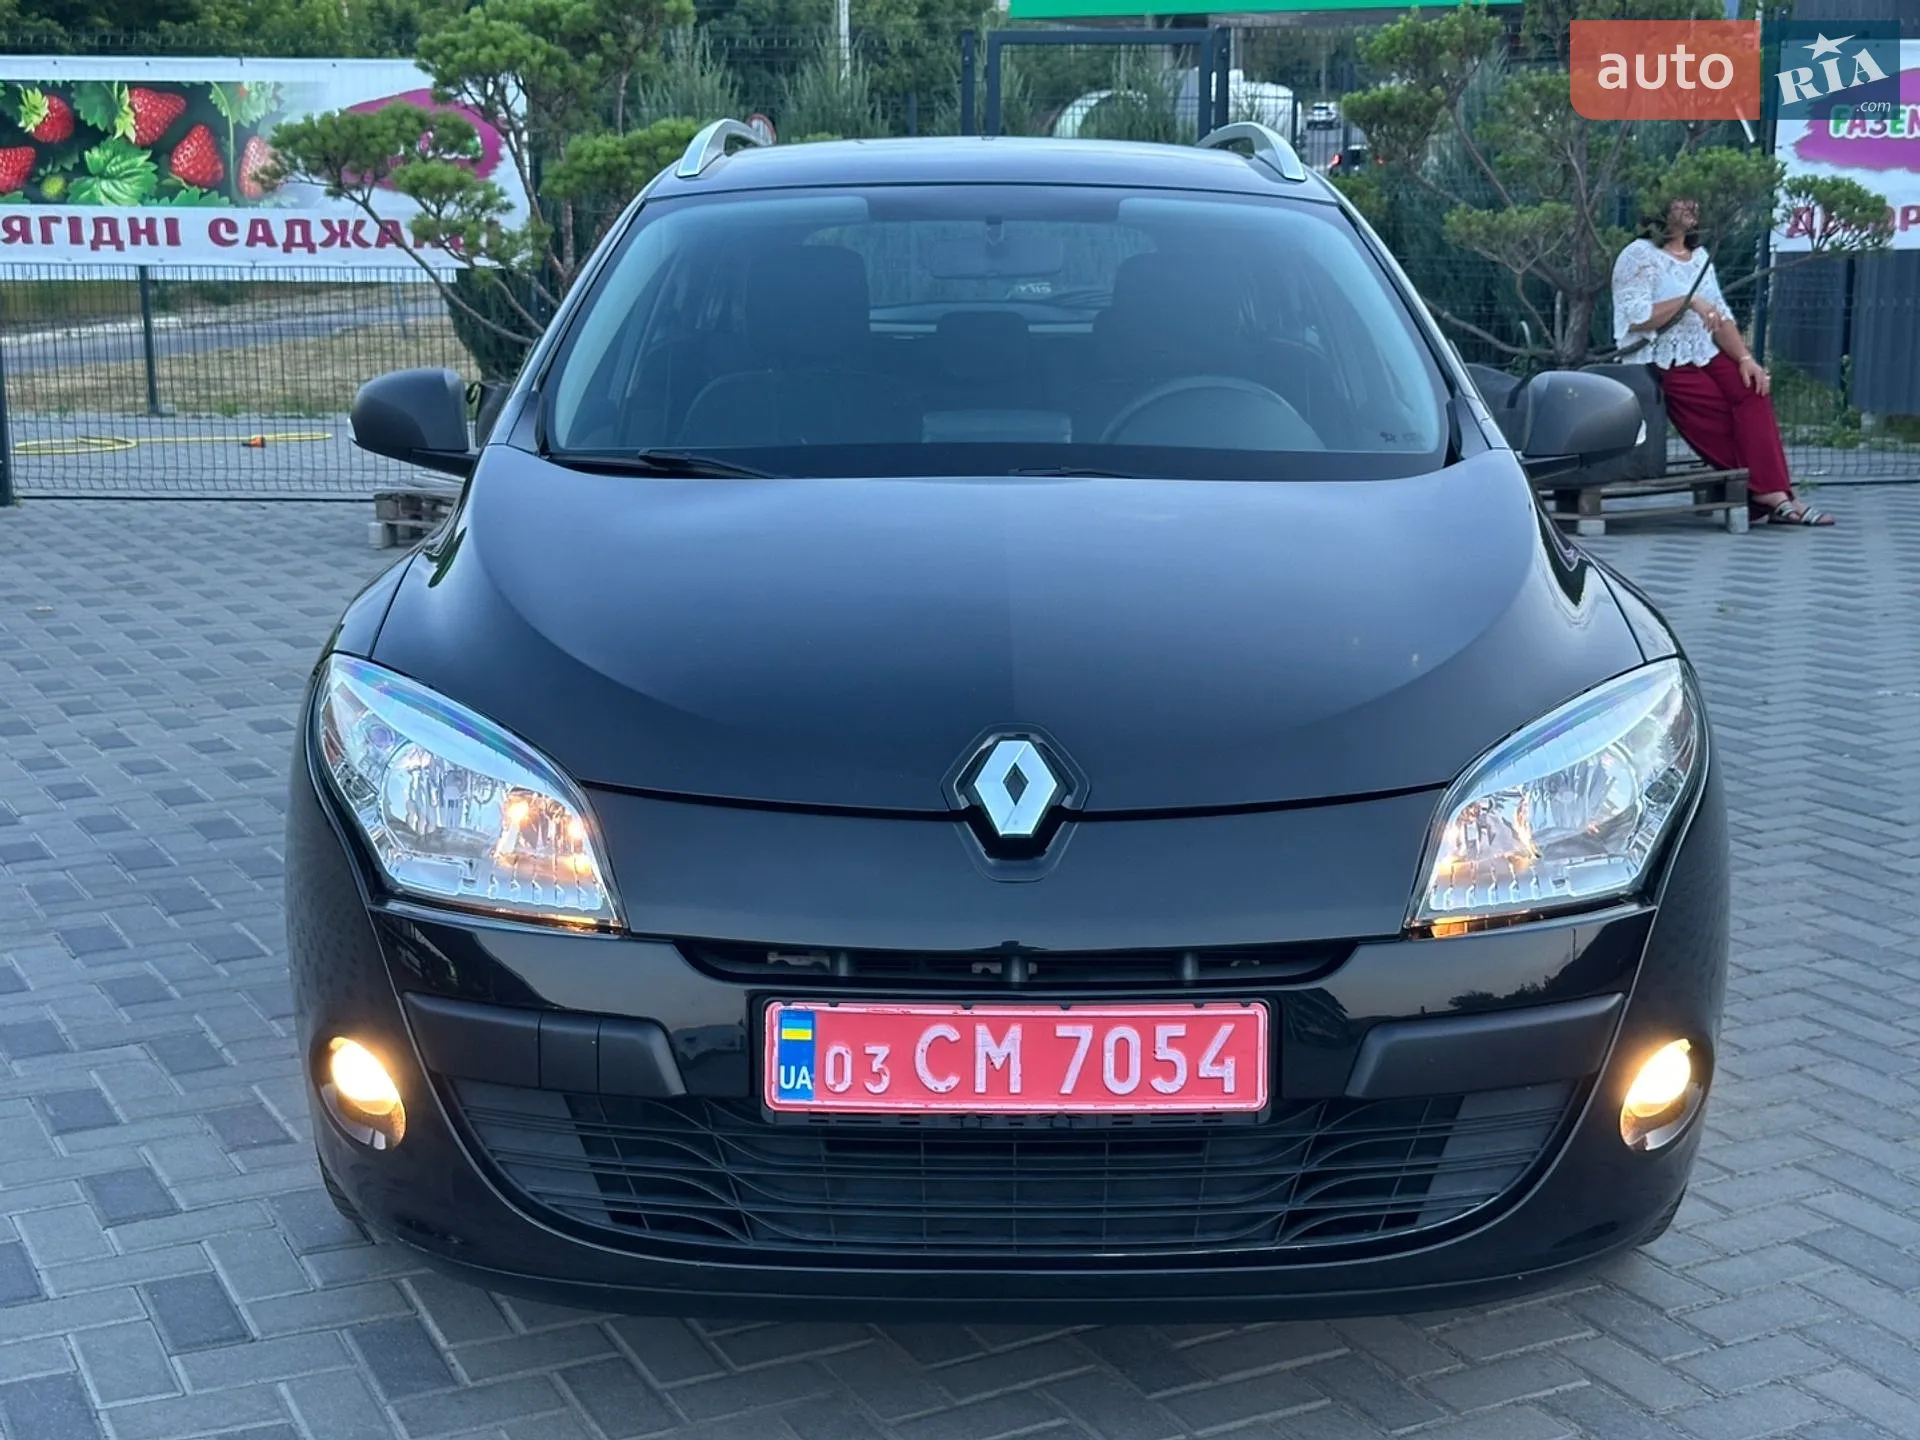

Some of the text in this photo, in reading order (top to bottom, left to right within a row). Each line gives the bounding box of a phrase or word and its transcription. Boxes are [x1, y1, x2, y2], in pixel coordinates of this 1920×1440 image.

[1, 214, 500, 254] ЯГІДНІ САДЖА
[779, 1064, 813, 1090] UA
[825, 1023, 1236, 1095] 03 CM 7054
